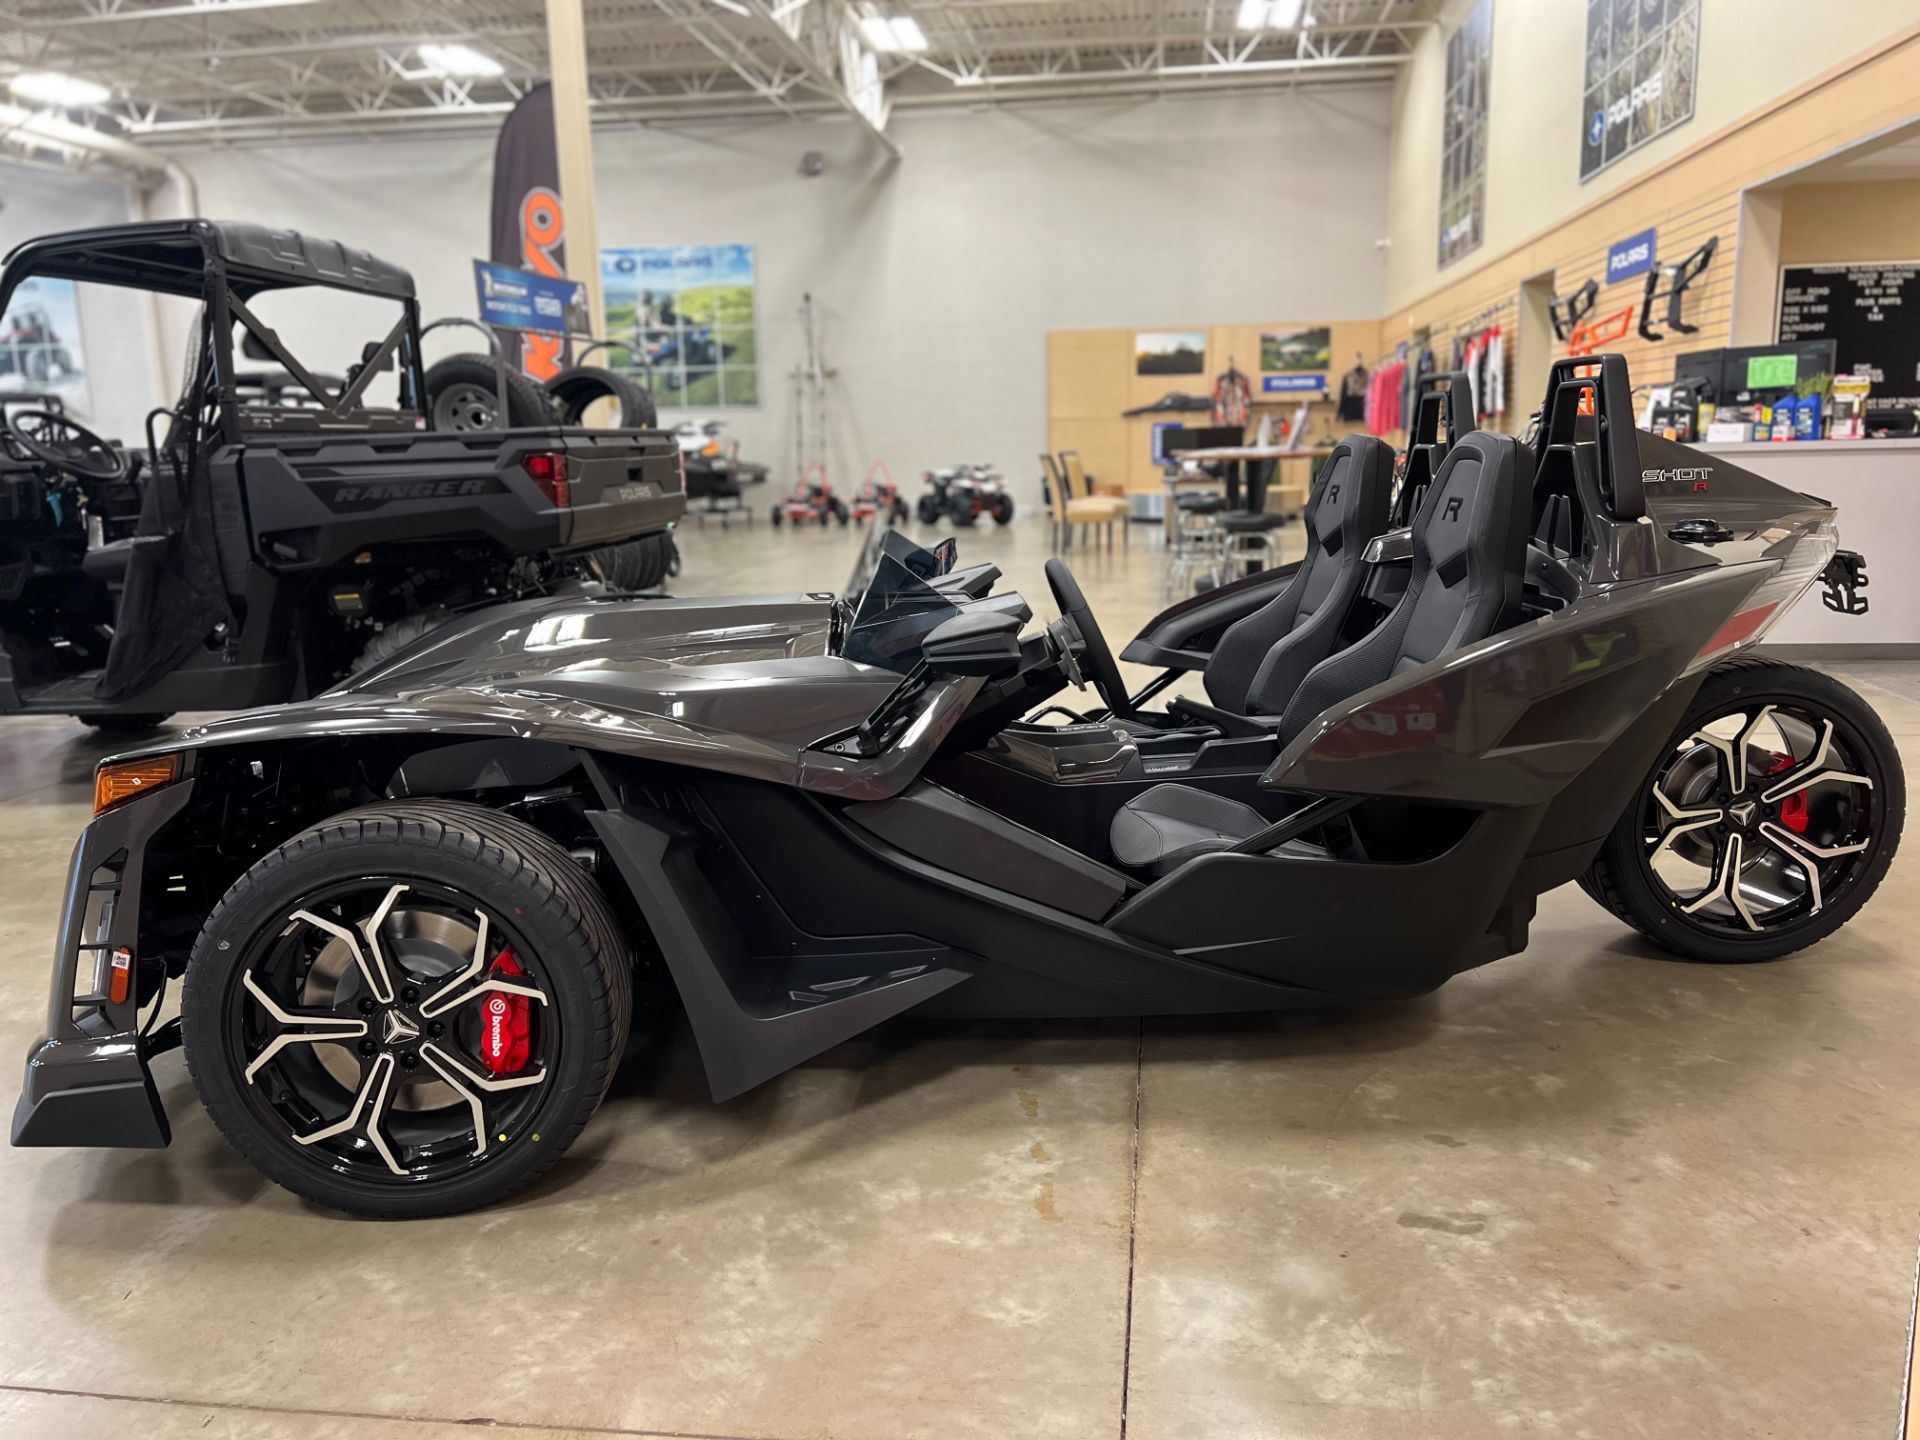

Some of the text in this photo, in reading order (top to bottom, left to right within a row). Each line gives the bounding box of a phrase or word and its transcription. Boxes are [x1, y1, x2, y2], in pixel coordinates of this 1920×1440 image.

[1611, 243, 1649, 271] POLARIS
[334, 479, 486, 503] RANGER
[619, 485, 652, 501] POLARIS
[1326, 485, 1341, 504] R
[1693, 481, 1708, 492] R
[1442, 496, 1464, 522] R
[491, 1015, 503, 1057] brembo
